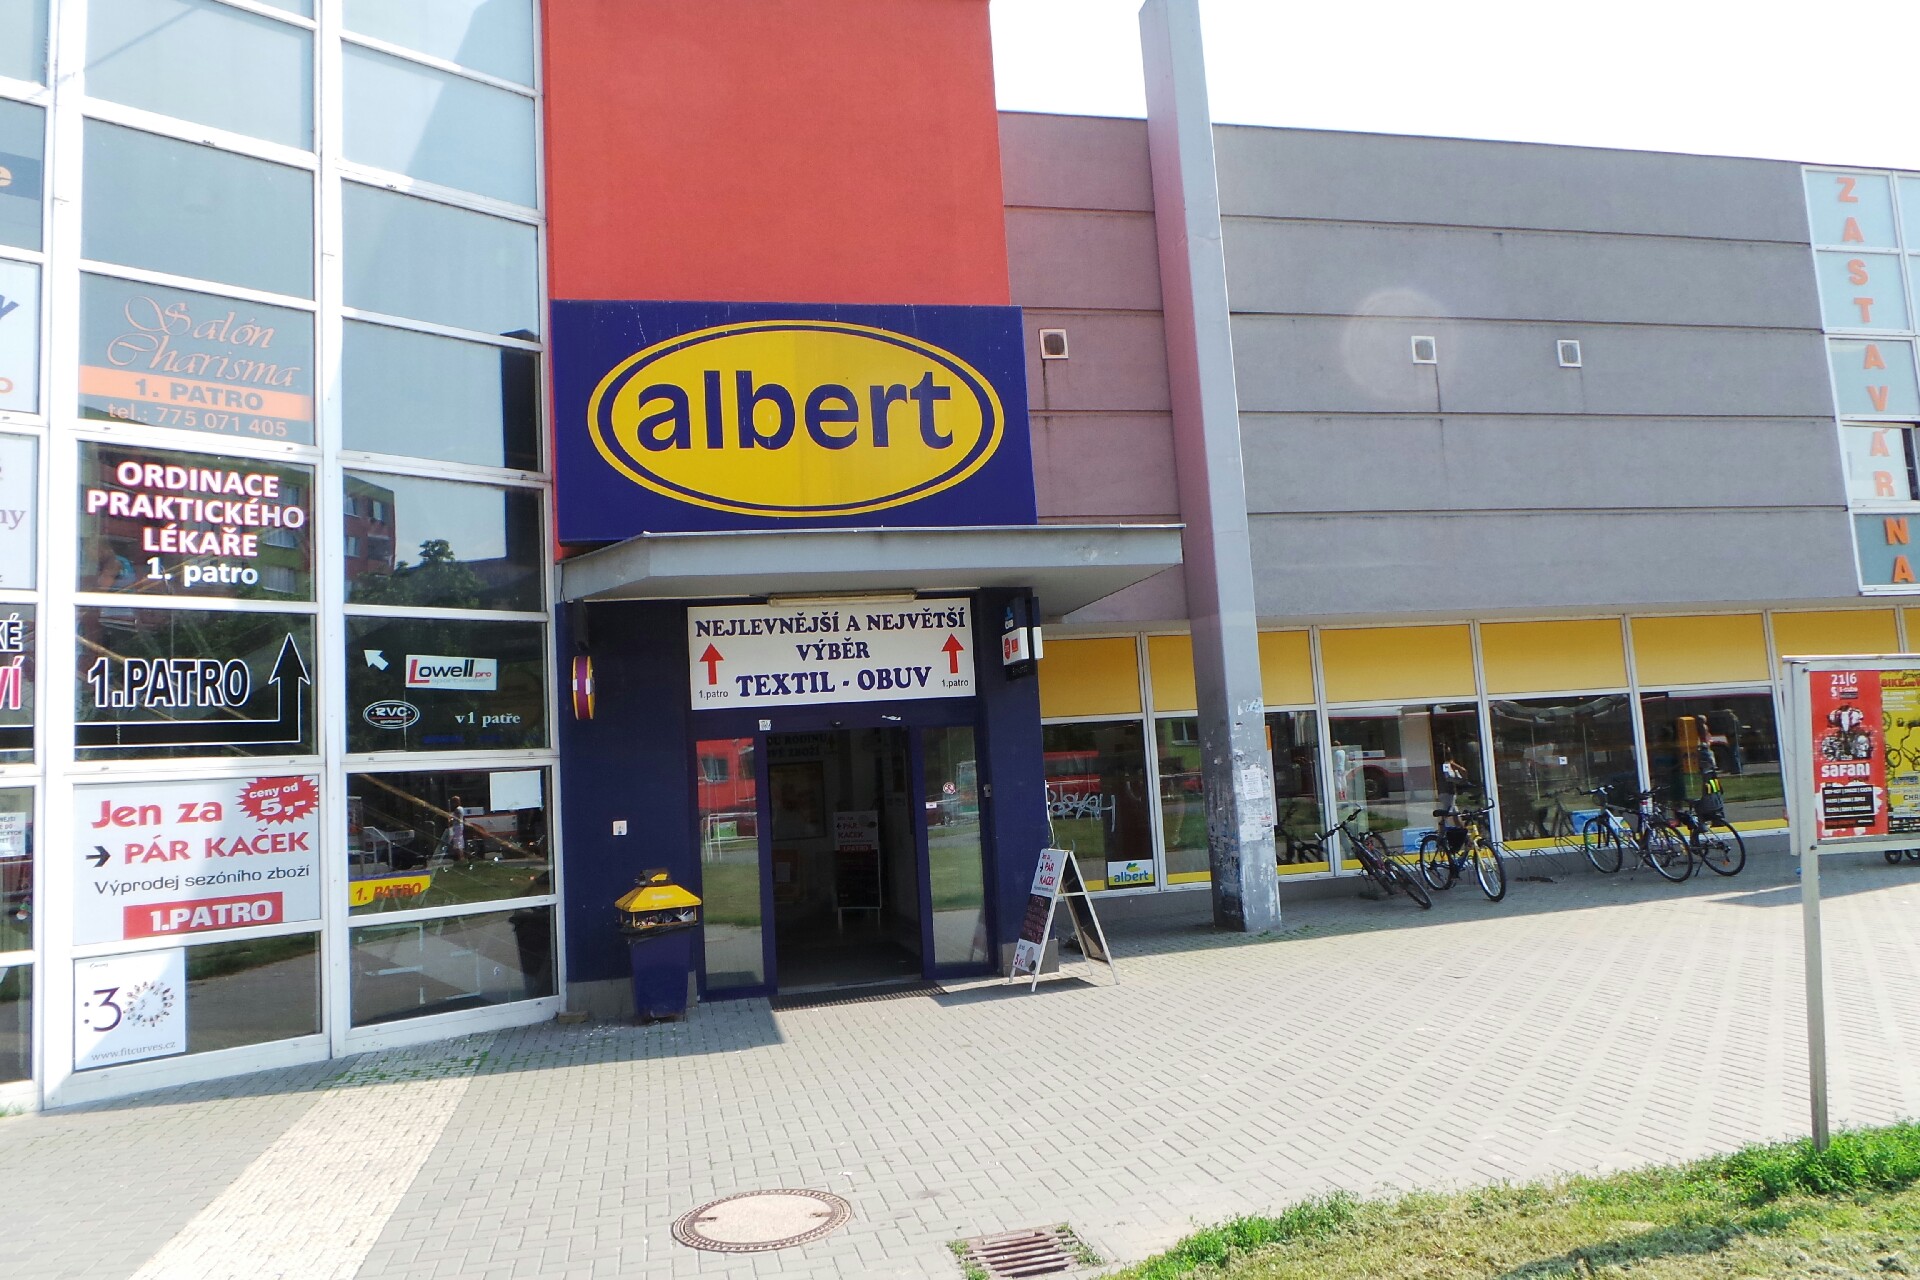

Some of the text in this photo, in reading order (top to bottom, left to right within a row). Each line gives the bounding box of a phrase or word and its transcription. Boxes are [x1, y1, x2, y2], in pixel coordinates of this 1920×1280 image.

[124, 296, 275, 348] Salón
[107, 333, 301, 387] Charisma
[135, 378, 263, 411] 1. PATRO
[1836, 177, 1916, 584] ZASTAVÁRNA
[108, 403, 288, 437] tel.: 775 071 405
[636, 370, 954, 451] albert
[116, 461, 279, 498] ORDINACE
[87, 489, 304, 529] PRAKTICKÉHO
[143, 520, 258, 557] LÉKAŘE
[146, 557, 258, 587] 1. patro
[695, 606, 966, 638] NEJLEVNĚJŠÍ A NEJVĚTŠÍ
[796, 637, 871, 661] VÝBĚR
[88, 657, 250, 708] 1.PATRO
[408, 659, 492, 684] Lowell pro
[735, 670, 836, 698] TEXTIL
[856, 666, 932, 691] OBUV
[941, 677, 969, 689] 1.patro
[698, 688, 729, 700] 1.patro
[454, 711, 521, 728] v 1 patře
[249, 782, 299, 799] ceny od
[91, 800, 223, 829] Jen za
[125, 827, 310, 865] PÁR KAČEK
[94, 864, 310, 896] Výprodej sezóního zboží
[373, 882, 422, 899] PATRO
[1114, 869, 1149, 883] albert
[150, 900, 273, 932] 1.PATRO
[91, 1041, 176, 1061] www.fitcurves.cz
